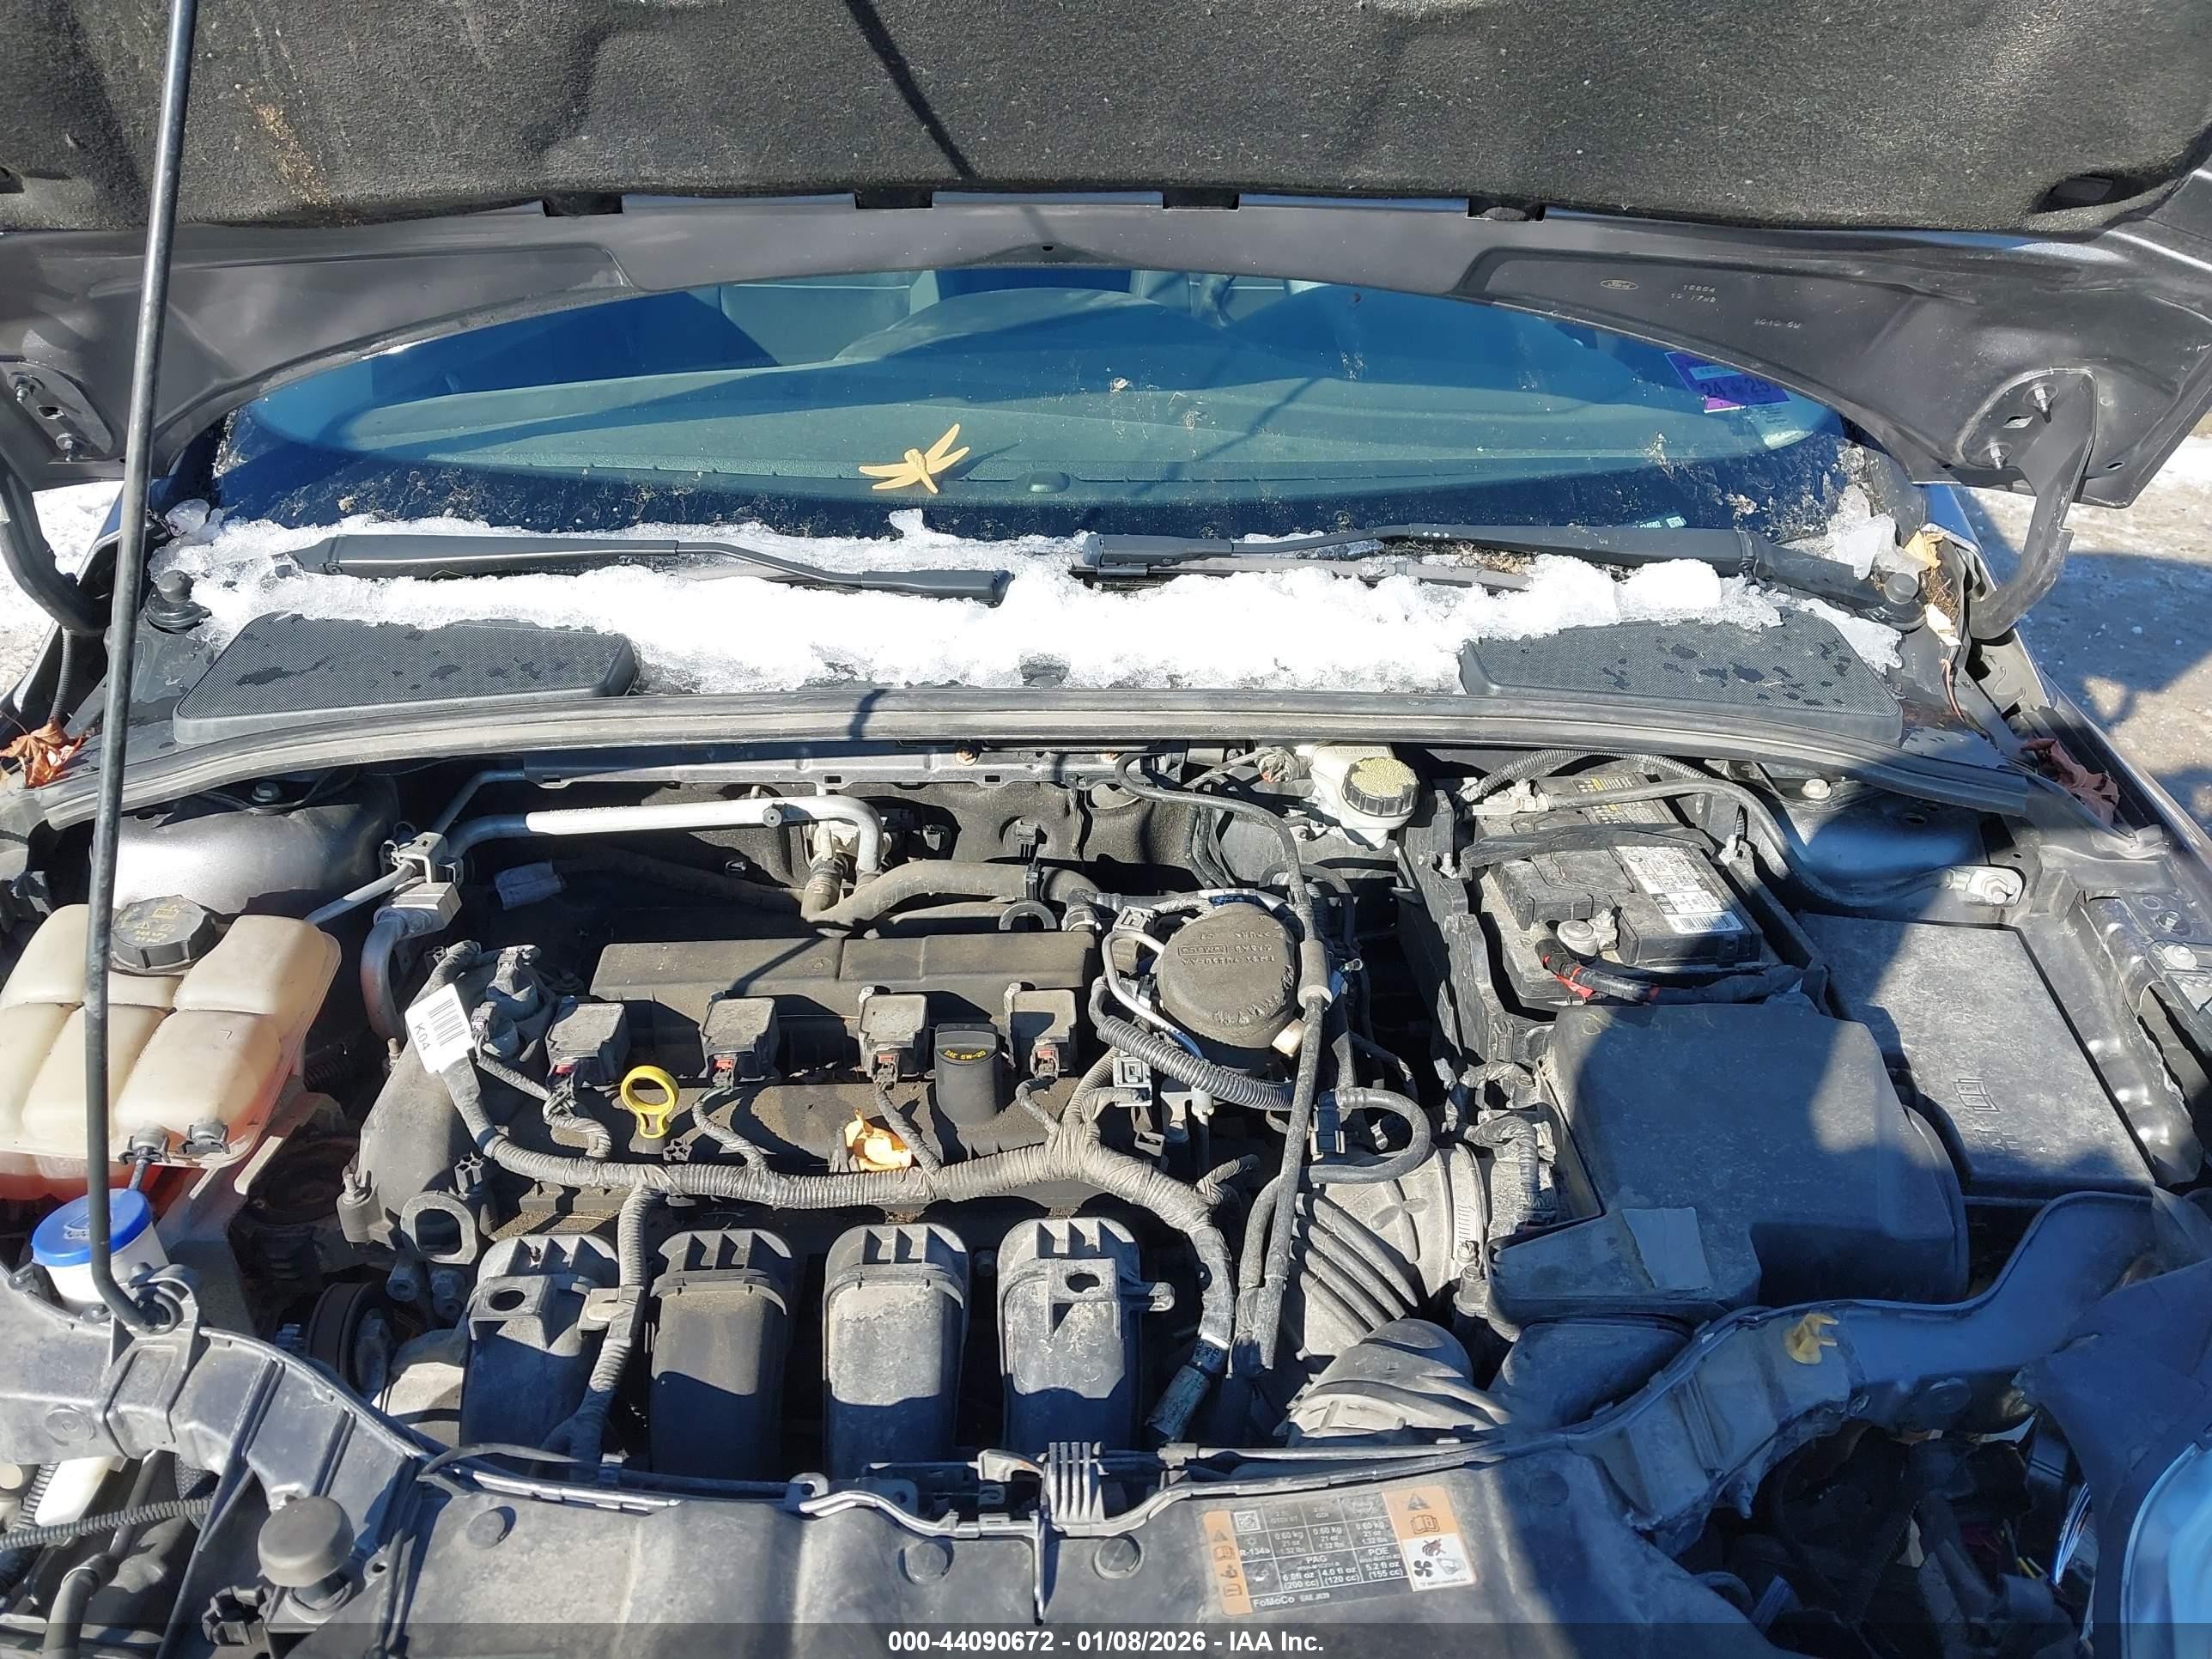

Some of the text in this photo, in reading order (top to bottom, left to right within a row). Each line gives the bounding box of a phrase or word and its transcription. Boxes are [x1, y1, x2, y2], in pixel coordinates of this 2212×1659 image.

[415, 1023, 431, 1050] K04
[1331, 1526, 1342, 1534] kg
[1374, 1521, 1385, 1529] kg
[1292, 1530, 1304, 1540] kg
[1239, 1547, 1271, 1556] R-134a
[1367, 1547, 1389, 1556] POE
[1305, 1555, 1328, 1565] PAG
[1365, 1562, 1380, 1571] 5.2
[1322, 1568, 1335, 1577] 4.0
[1368, 1568, 1404, 1580] (155 cc)
[1324, 1573, 1360, 1585] (120 cc)
[1283, 1578, 1320, 1591] (200 cc)
[1252, 1595, 1295, 1608] FoMoCo
